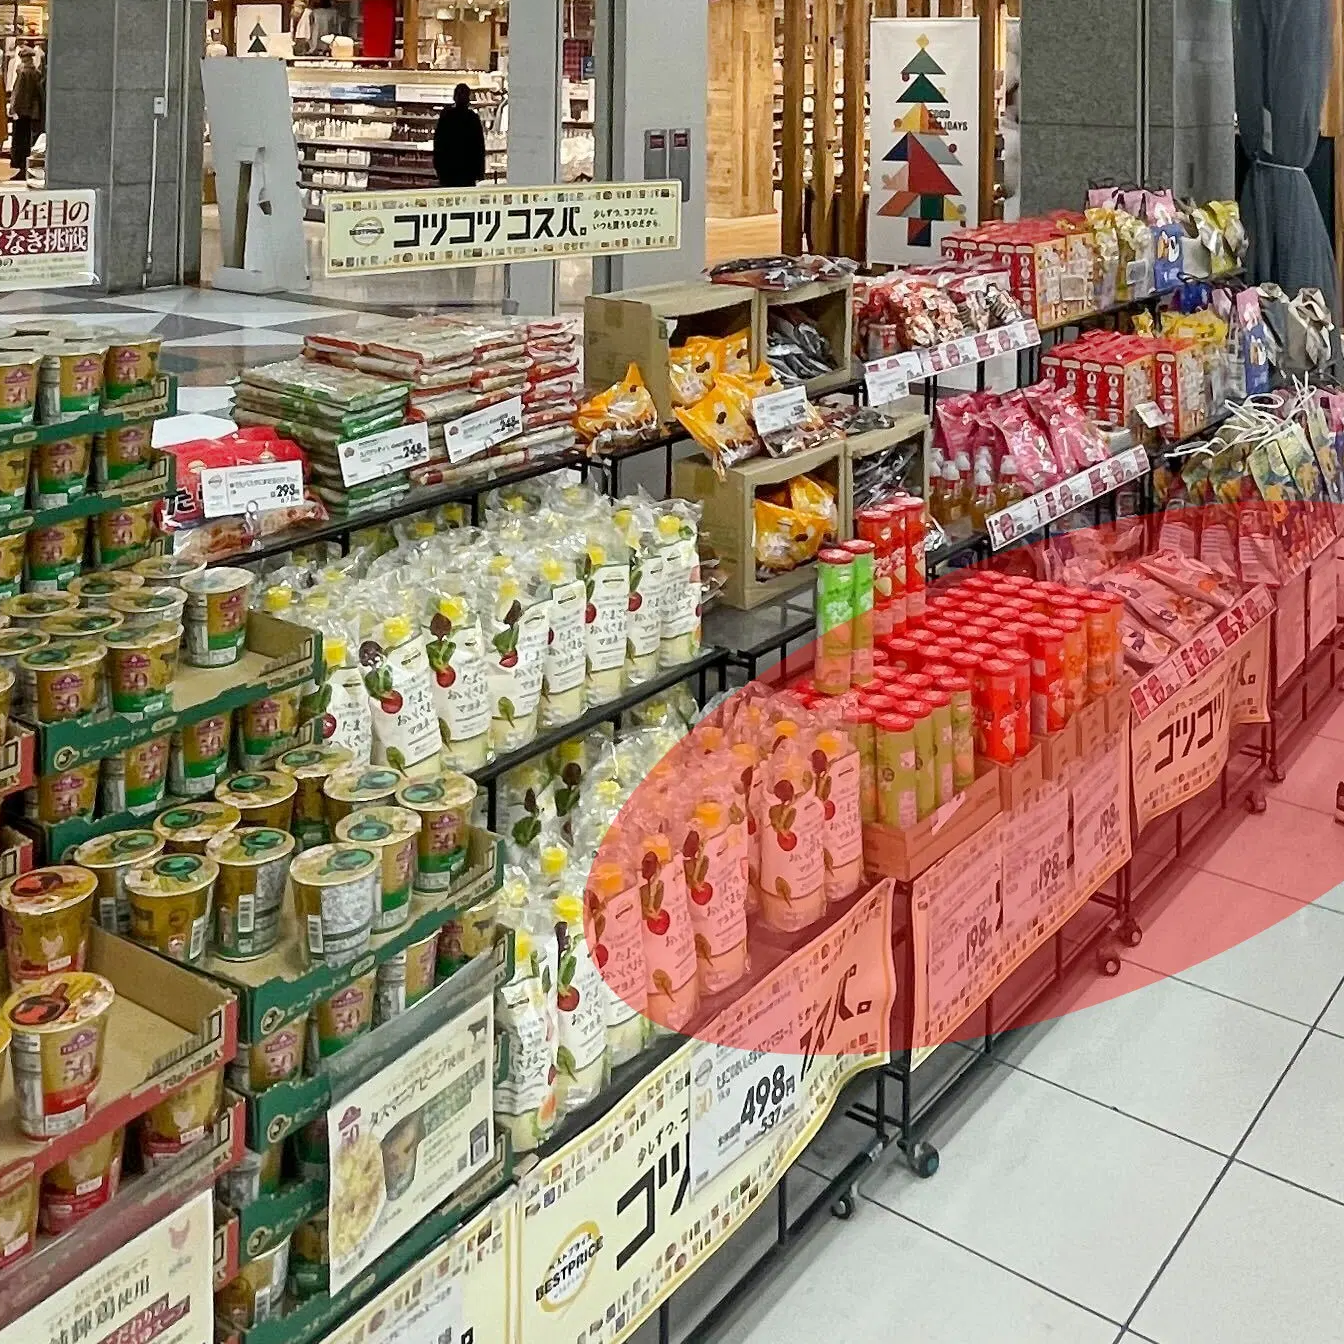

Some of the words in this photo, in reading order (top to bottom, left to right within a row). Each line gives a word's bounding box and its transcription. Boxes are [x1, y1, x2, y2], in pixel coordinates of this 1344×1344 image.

[1154, 686, 1225, 774] コツコツ
[740, 1064, 796, 1126] 498円
[535, 1235, 605, 1302] BESTPRICE
